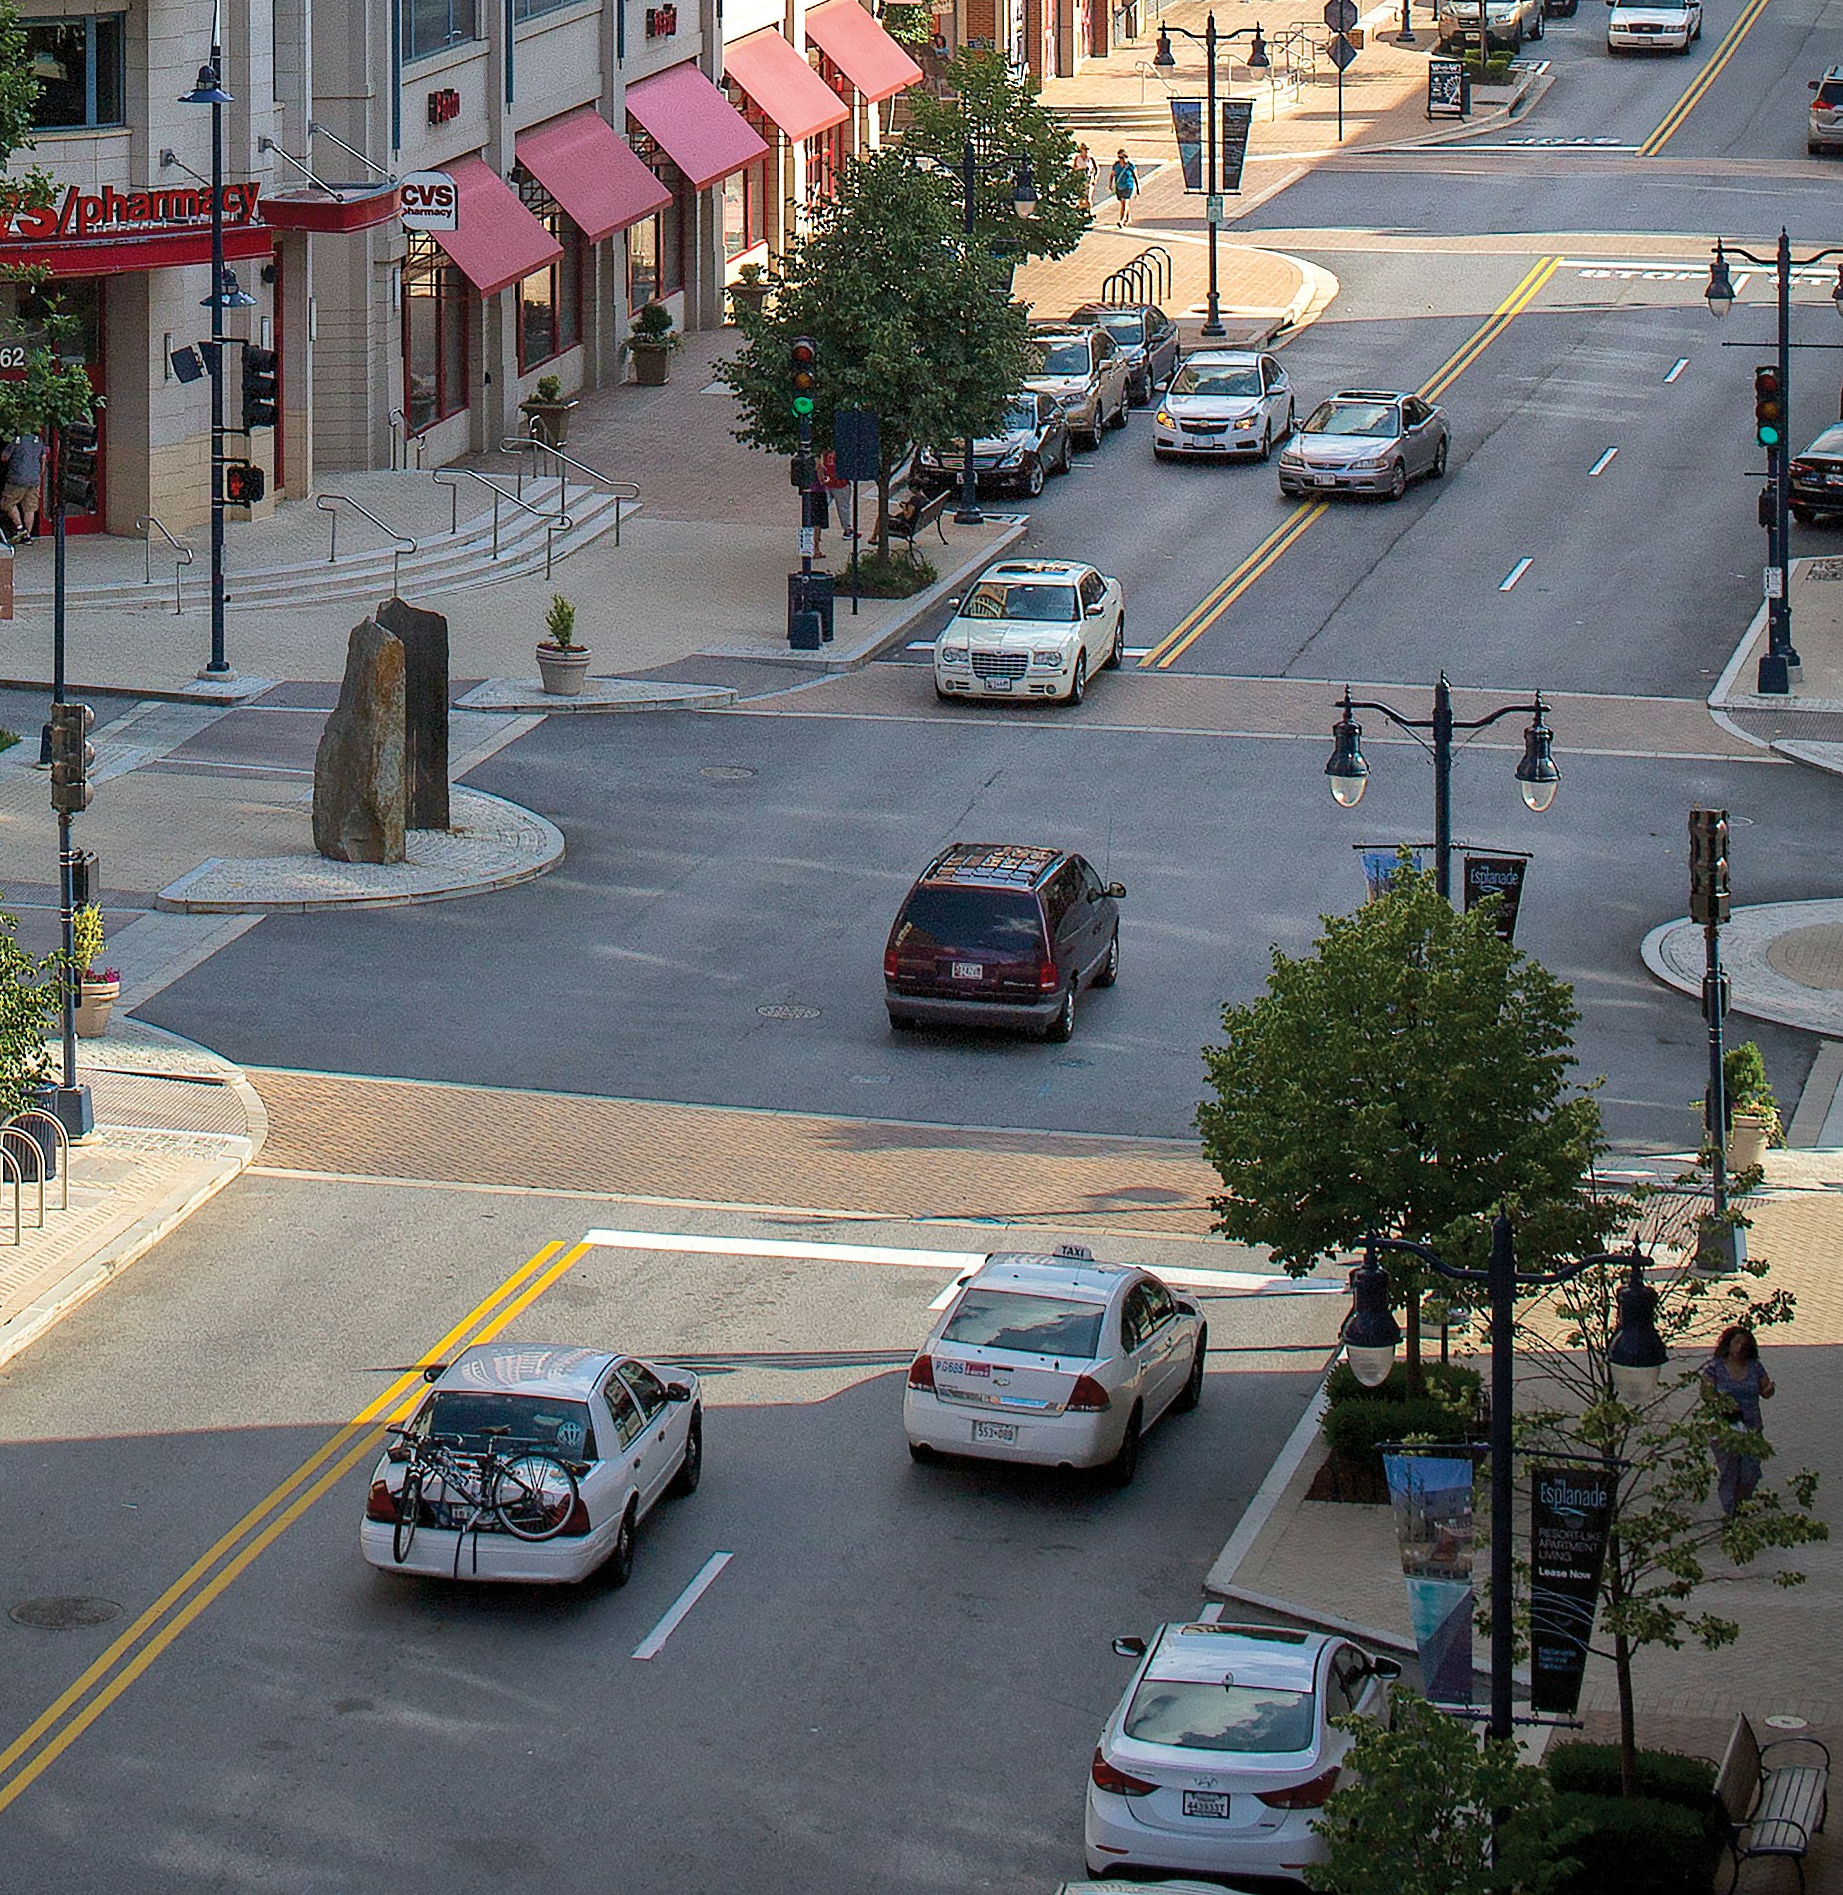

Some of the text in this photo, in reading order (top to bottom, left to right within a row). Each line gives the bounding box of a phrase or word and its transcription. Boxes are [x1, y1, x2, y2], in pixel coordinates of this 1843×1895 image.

[400, 184, 453, 206] CVS
[401, 207, 452, 218] pharmacy
[1470, 866, 1519, 888] Esplanade
[1061, 1245, 1084, 1257] TAXI
[1540, 1479, 1607, 1507] Esplanade
[1539, 1566, 1592, 1579] Lease Now
